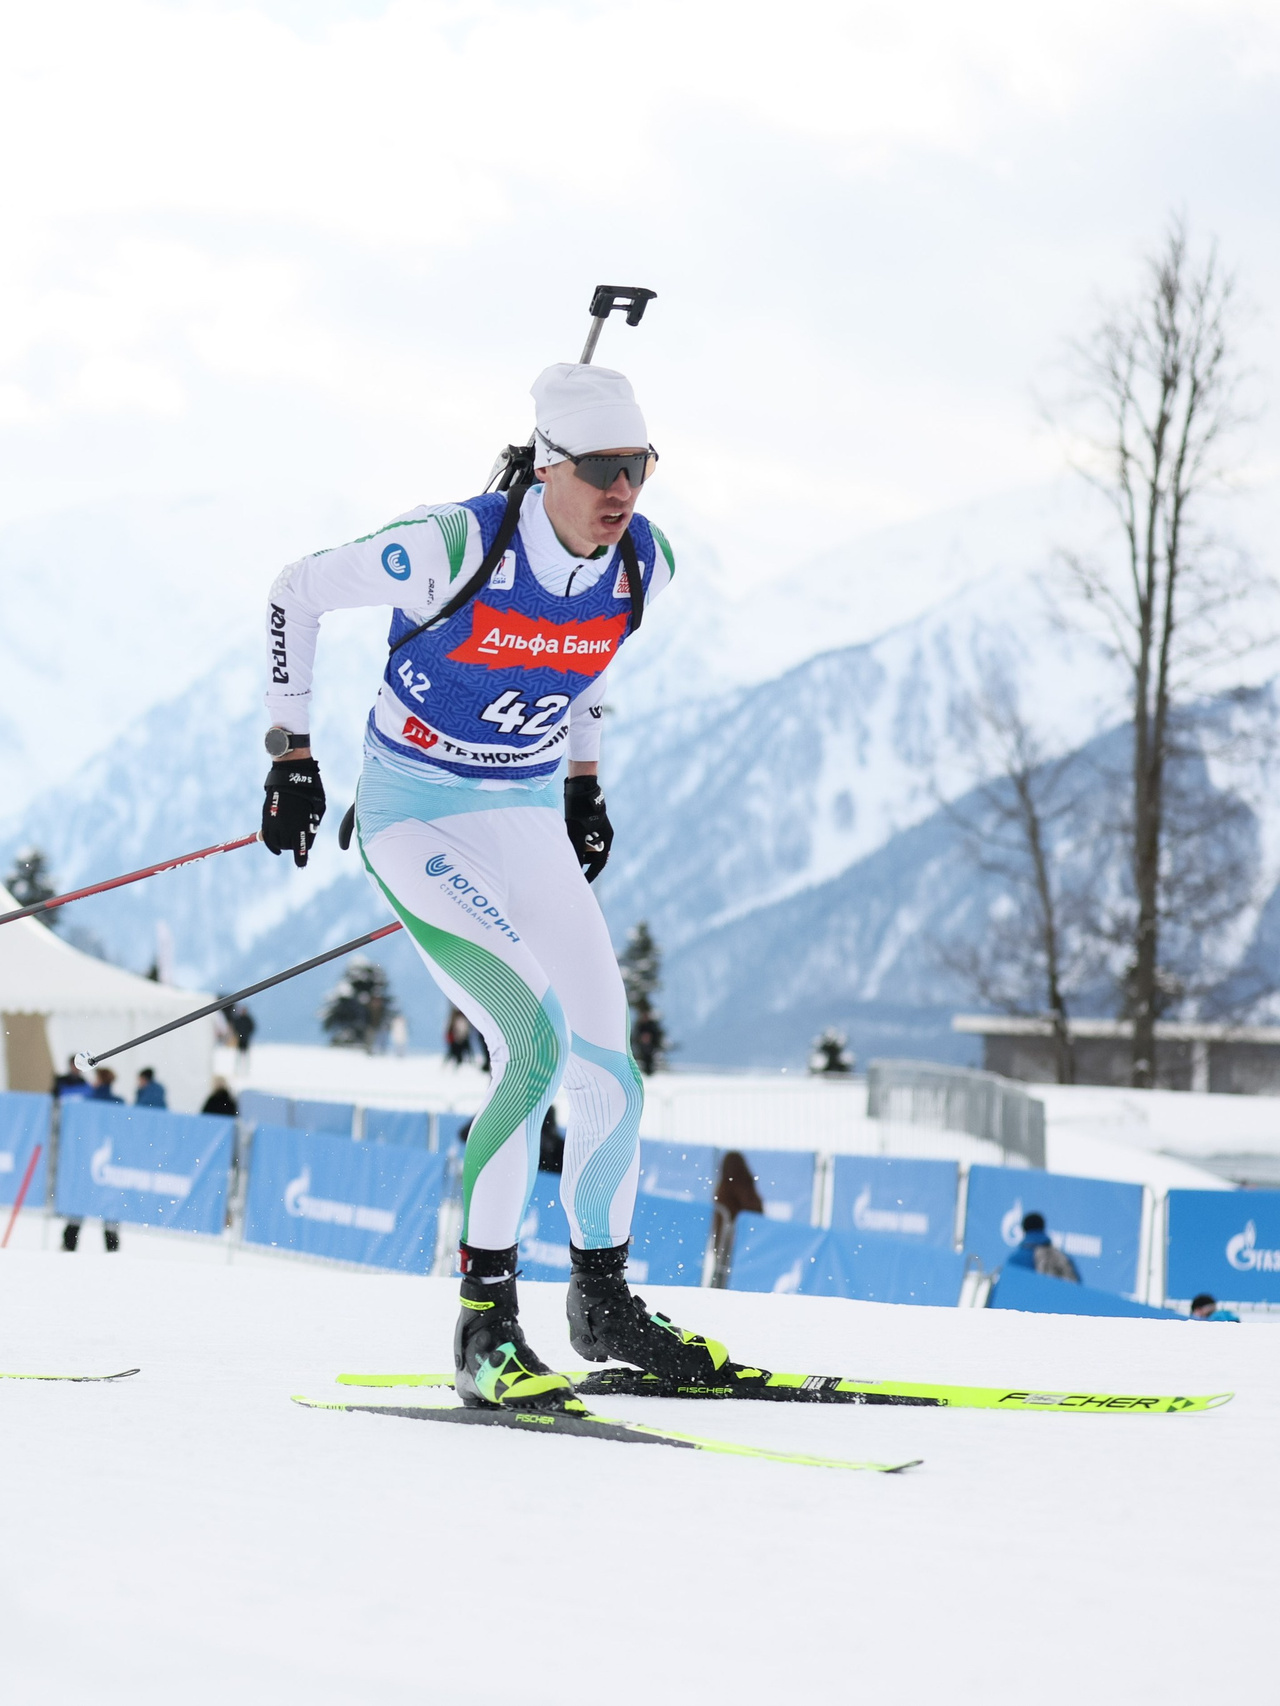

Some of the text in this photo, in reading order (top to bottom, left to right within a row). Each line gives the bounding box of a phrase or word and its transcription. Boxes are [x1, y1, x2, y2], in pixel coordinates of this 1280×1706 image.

[477, 627, 613, 657] Альфа Банк
[397, 659, 432, 704] 42
[479, 690, 571, 736] 42
[439, 883, 492, 931] СТРАХОВАНИЕ
[447, 873, 521, 943] ЮГОРИЯ
[676, 1386, 734, 1395] FISCHER
[515, 1412, 556, 1425] FISCHER
